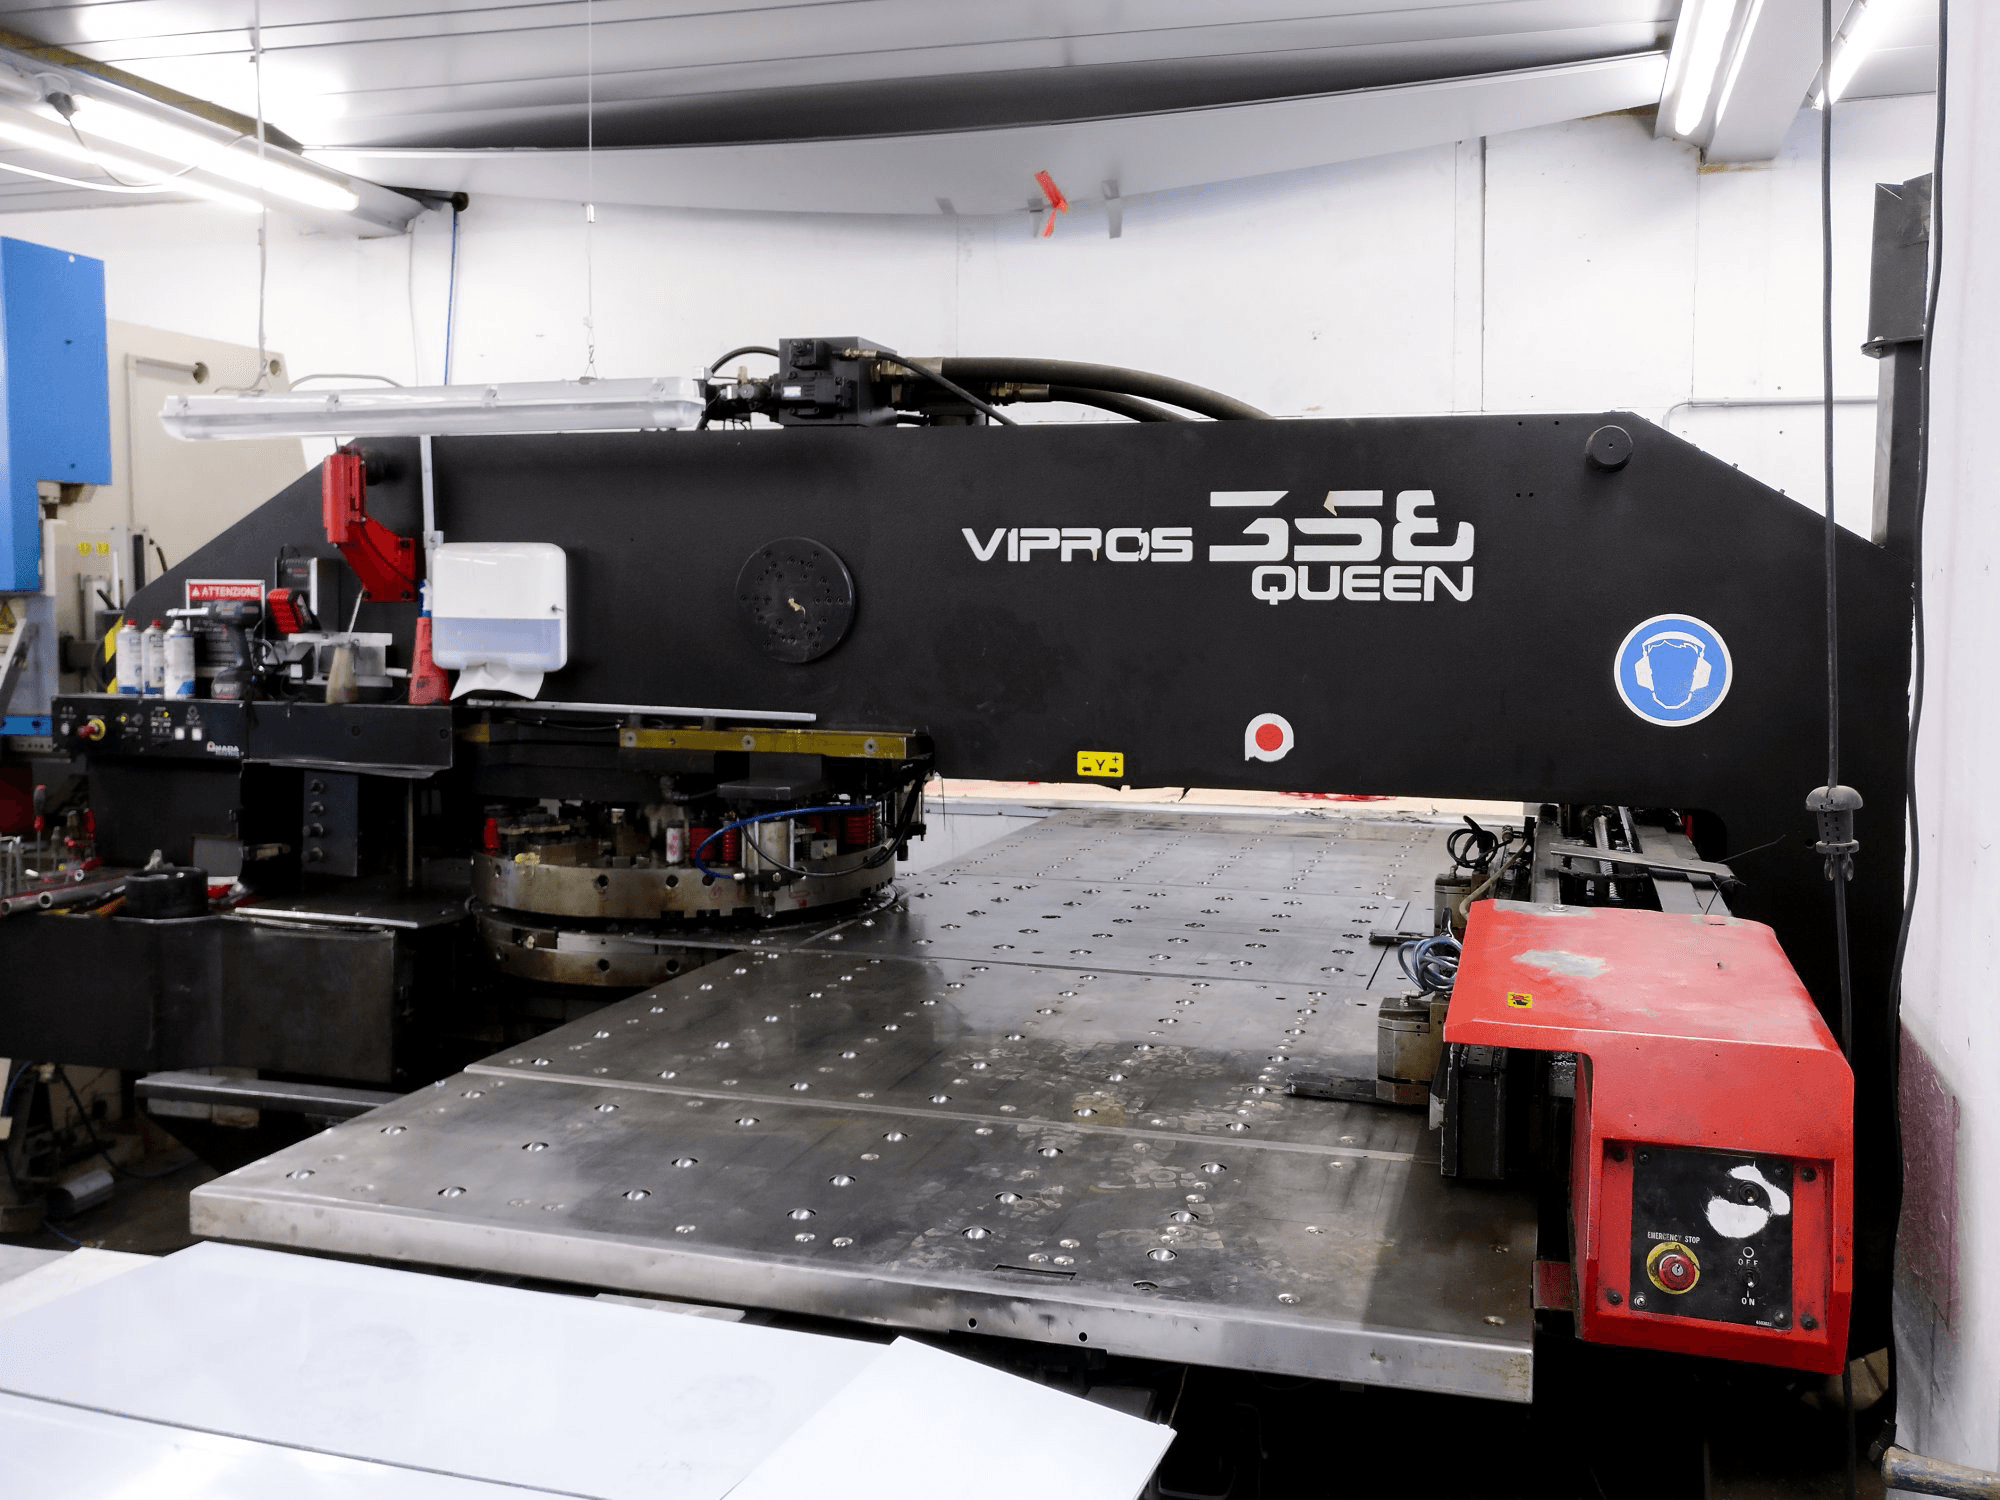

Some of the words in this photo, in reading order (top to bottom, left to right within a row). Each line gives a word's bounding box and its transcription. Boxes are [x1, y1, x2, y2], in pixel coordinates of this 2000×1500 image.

[962, 526, 1193, 562] VIPROS
[1251, 565, 1475, 605] QUEEN
[202, 586, 259, 597] ATTENZIONE
[1096, 759, 1105, 770] Y
[1647, 1231, 1682, 1242] EMERGENCY
[1684, 1235, 1701, 1244] STOP
[1741, 1297, 1756, 1306] ON
